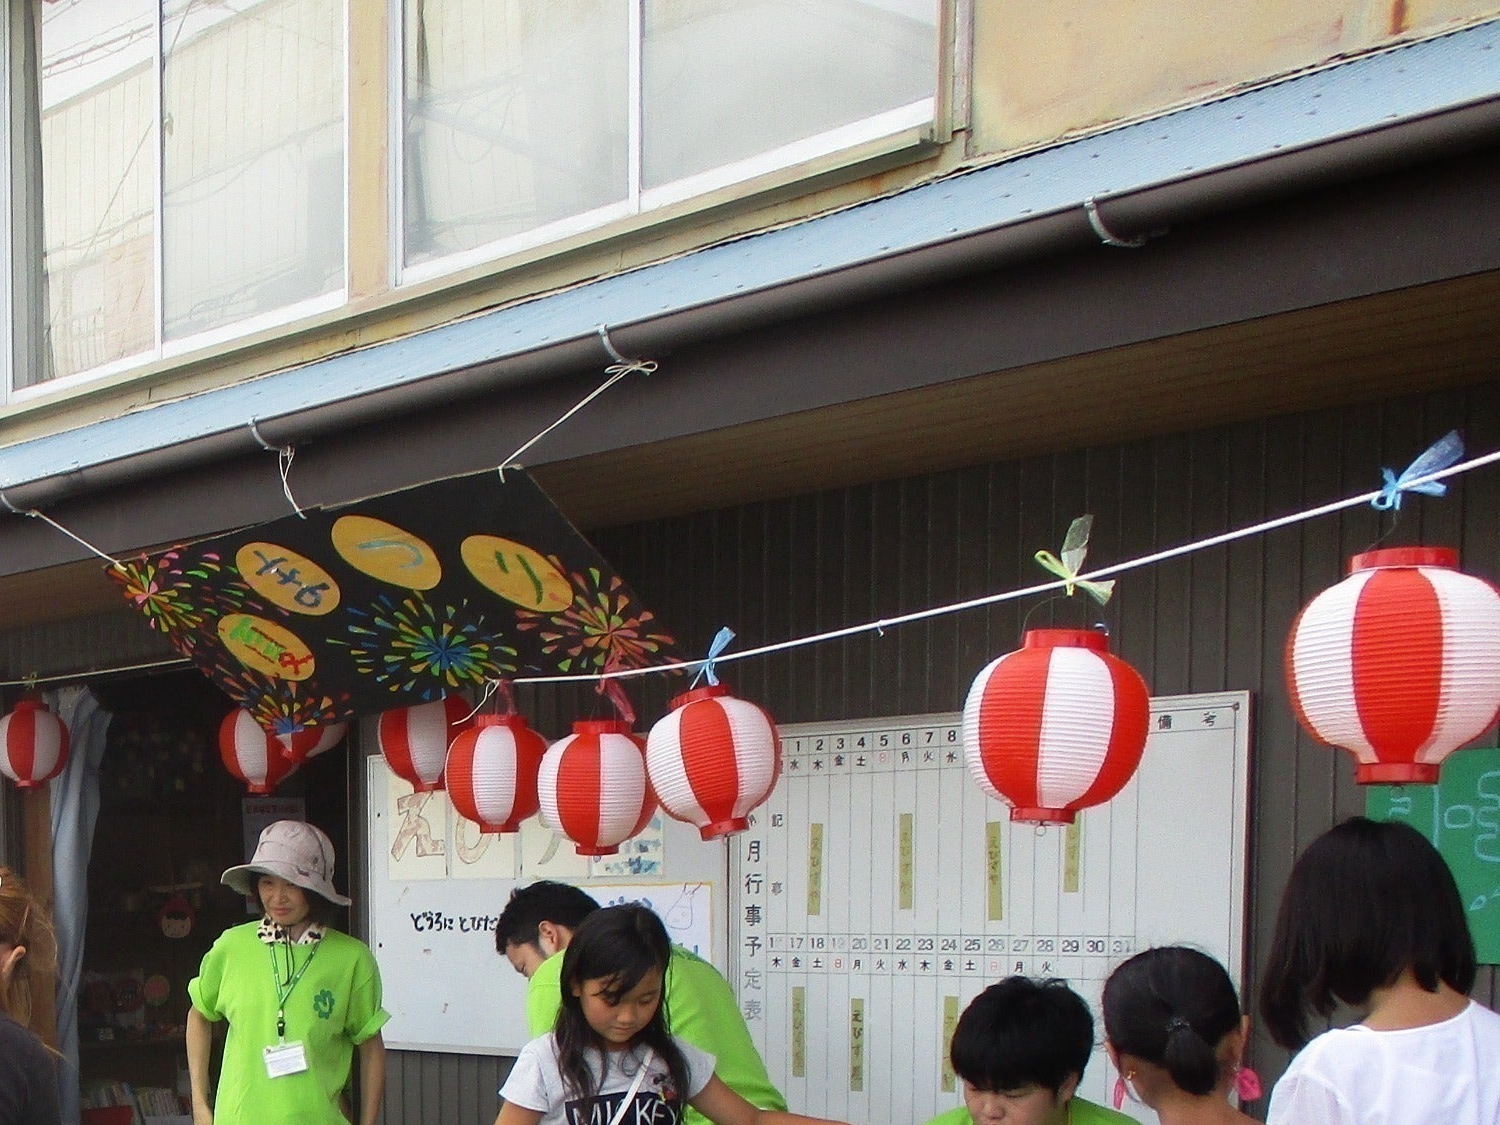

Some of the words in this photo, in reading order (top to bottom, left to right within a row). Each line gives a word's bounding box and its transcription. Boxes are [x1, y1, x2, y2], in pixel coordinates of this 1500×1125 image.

[795, 741, 801, 752] 1
[816, 739, 824, 751] 2
[836, 738, 845, 749] 3
[857, 736, 866, 748] 4
[879, 735, 888, 747] 5
[901, 733, 911, 745] 6
[925, 732, 934, 744] 7
[947, 730, 957, 742] 8
[813, 759, 824, 771] 木
[834, 755, 845, 766] 金
[856, 756, 867, 767] 土
[901, 751, 910, 763] 月
[923, 751, 934, 762] 火
[946, 752, 958, 763] 水
[789, 938, 804, 949] 17
[811, 938, 825, 949] 18
[852, 938, 868, 950] 20
[874, 938, 890, 950] 21
[896, 939, 911, 950] 22
[918, 939, 934, 950] 23
[941, 939, 957, 951] 24
[964, 939, 981, 952] 25
[988, 940, 1005, 952] 26
[1012, 940, 1029, 952] 27
[1037, 940, 1054, 952] 28
[1061, 940, 1080, 953] 29
[1087, 940, 1105, 953] 30
[771, 957, 782, 968] 木
[792, 957, 802, 968] 金
[812, 957, 823, 968] 土
[852, 958, 862, 969] 月
[876, 959, 886, 969] 火
[898, 959, 908, 970] 水
[920, 959, 930, 970] 木
[943, 960, 954, 971] 金
[965, 960, 976, 971] 土
[1014, 961, 1024, 973] 月
[1041, 961, 1052, 973] 火
